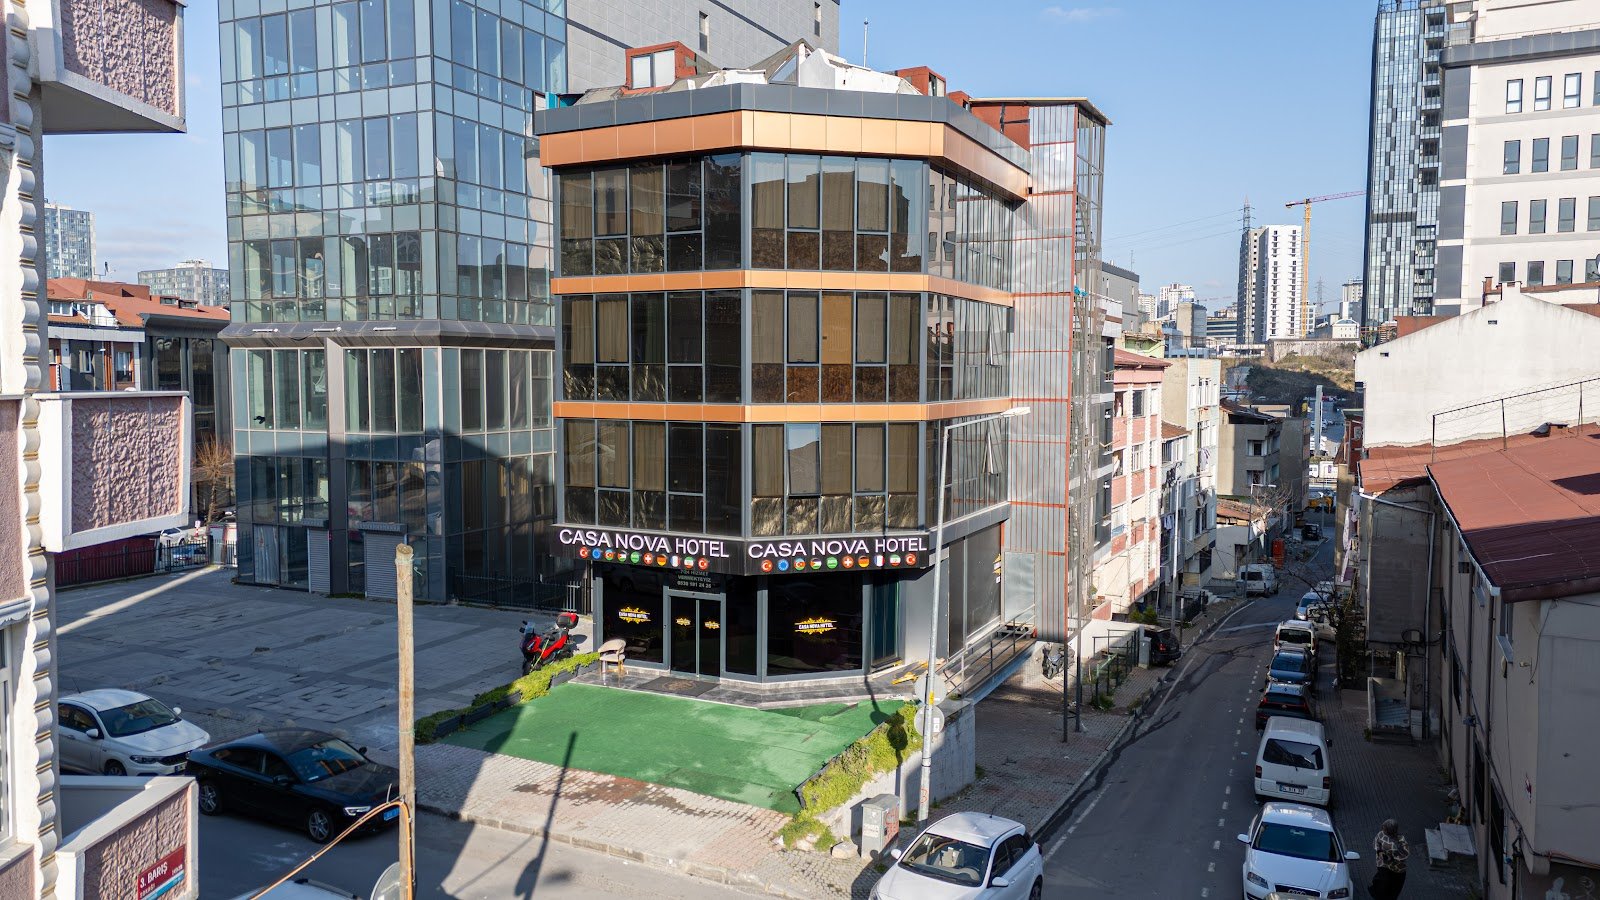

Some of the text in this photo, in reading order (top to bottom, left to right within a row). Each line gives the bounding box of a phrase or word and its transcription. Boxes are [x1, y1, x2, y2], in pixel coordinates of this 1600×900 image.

[559, 529, 729, 558] CASA NOVA HOTEL
[748, 538, 927, 558] CASA NOVA HOTEL
[140, 877, 146, 889] 3.
[148, 862, 168, 884] BARIŞ
